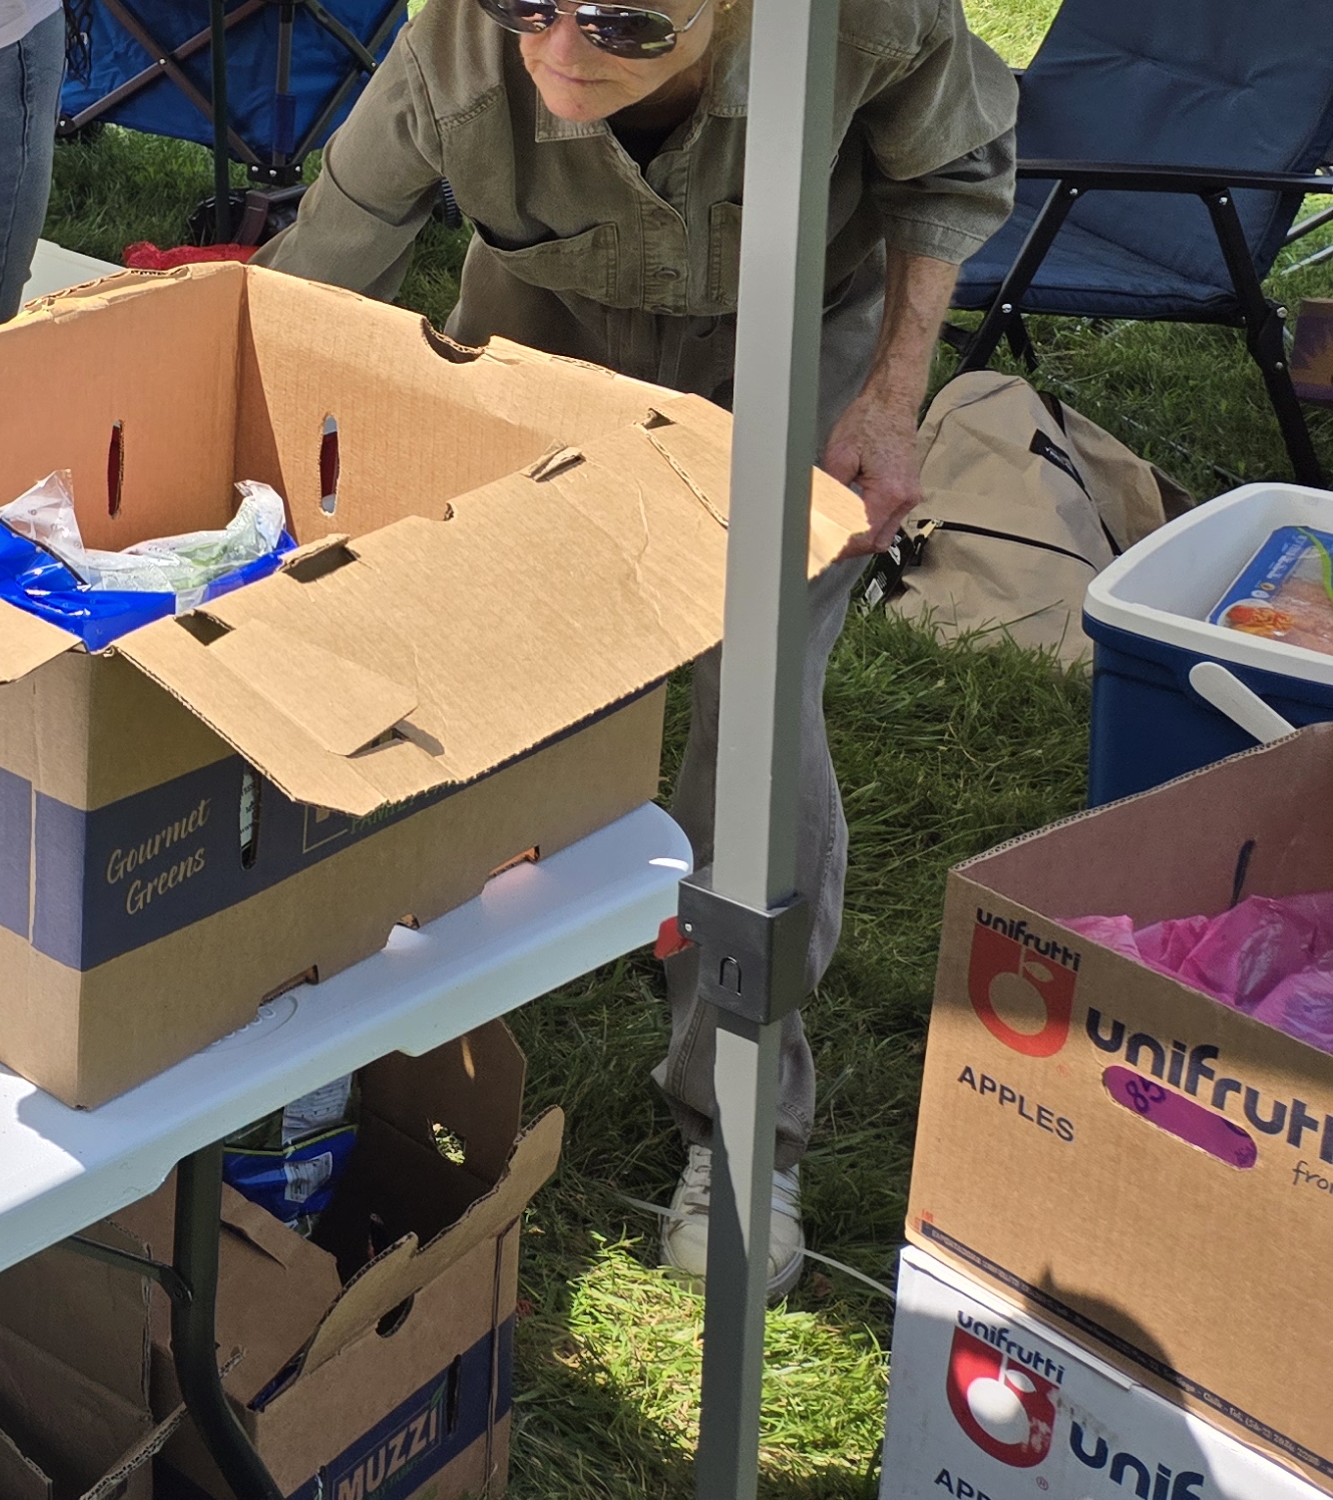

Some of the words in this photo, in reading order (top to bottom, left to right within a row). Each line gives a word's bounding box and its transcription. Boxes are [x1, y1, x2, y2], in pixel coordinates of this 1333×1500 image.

[106, 797, 212, 886] Gourmet
[125, 846, 208, 917] Greens
[976, 907, 1081, 972] unifrutti
[957, 1065, 1077, 1144] APPLES
[1291, 1160, 1333, 1195] fro
[957, 1310, 1066, 1385] unifrutti
